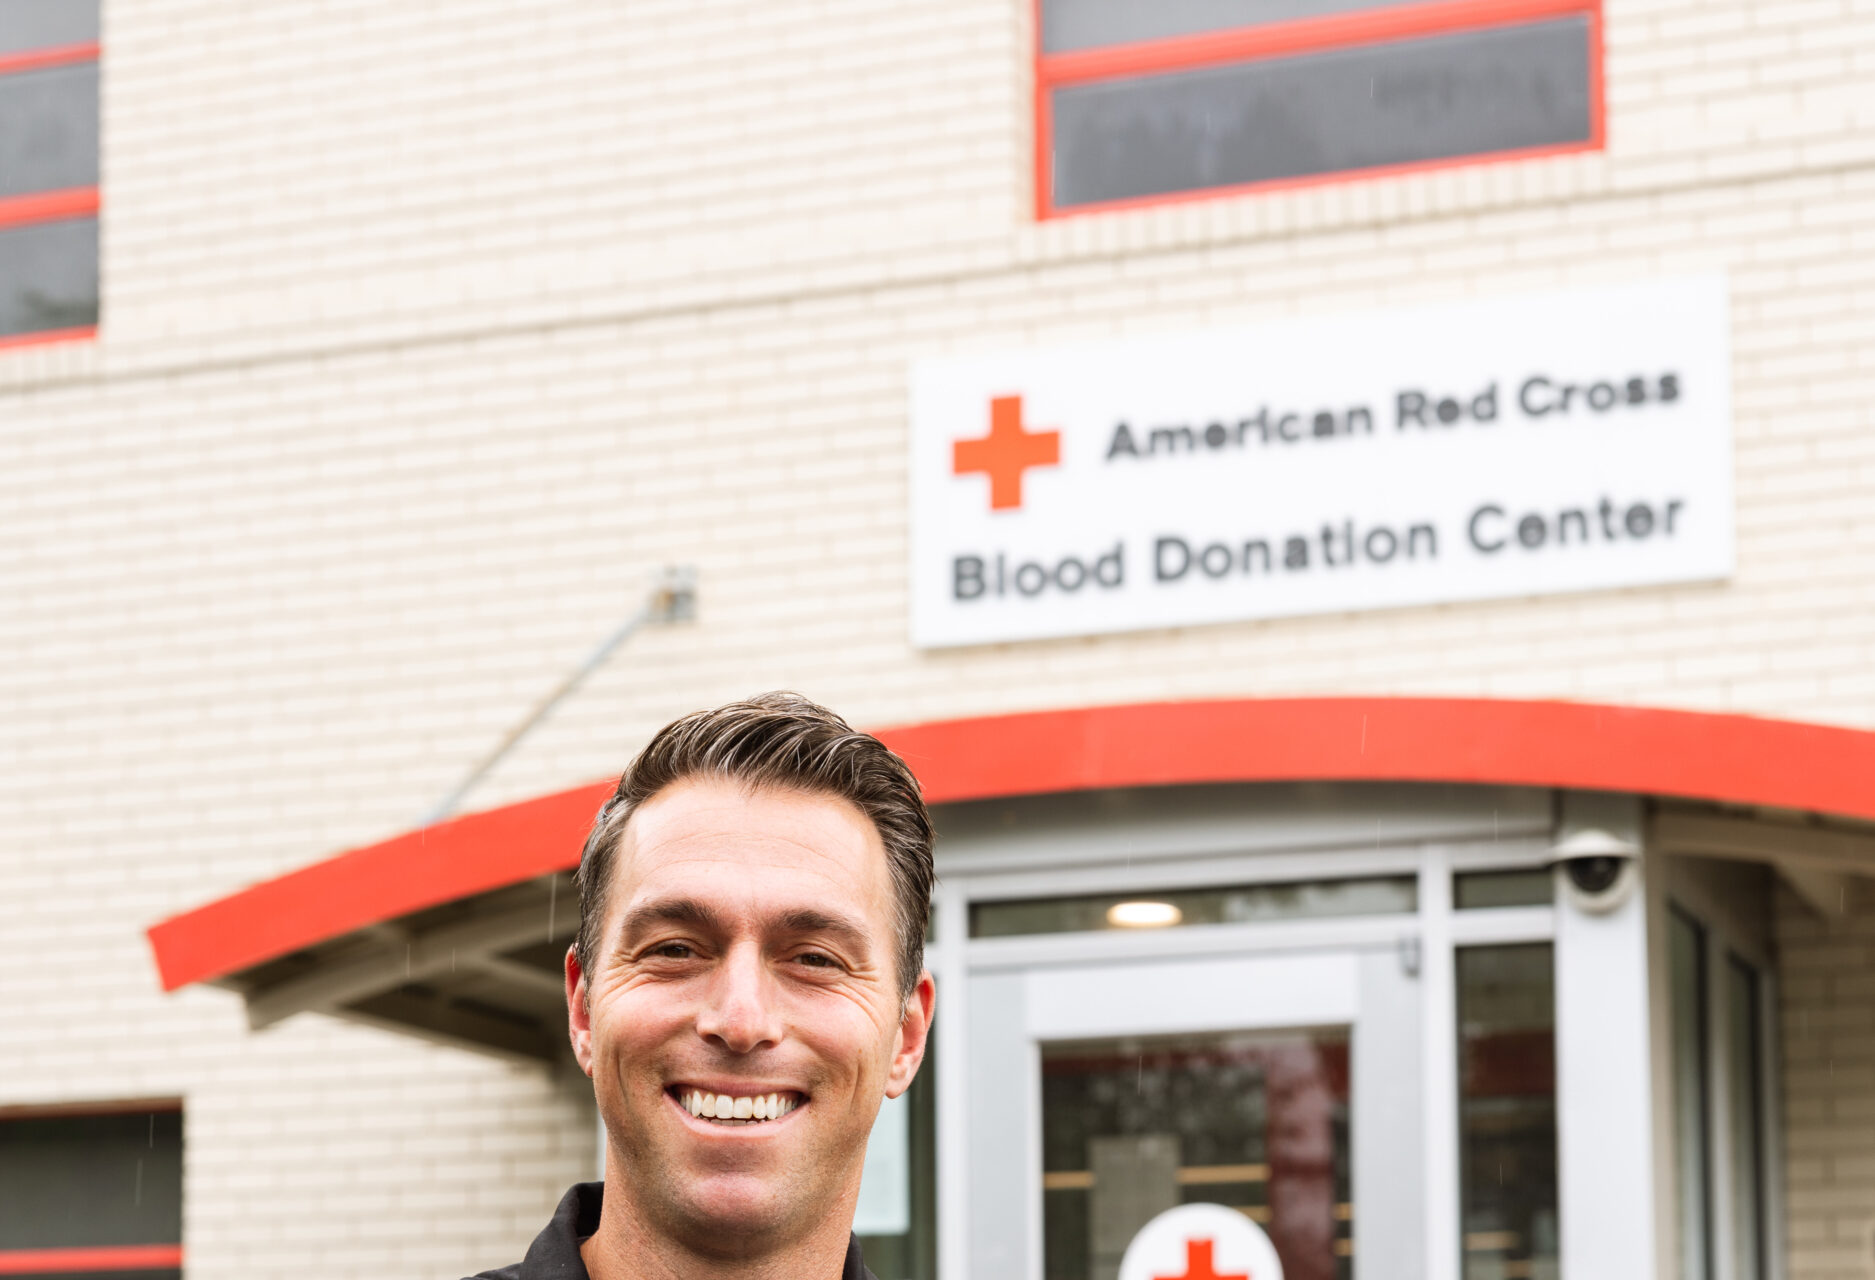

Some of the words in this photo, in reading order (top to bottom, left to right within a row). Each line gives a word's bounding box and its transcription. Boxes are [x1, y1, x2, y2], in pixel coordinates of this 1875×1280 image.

[1105, 402, 1374, 462] American
[1395, 382, 1500, 431] Red
[1517, 368, 1682, 418] Cross
[952, 540, 1126, 602] Blood
[1154, 518, 1438, 583] Donation
[1467, 494, 1685, 554] Center
